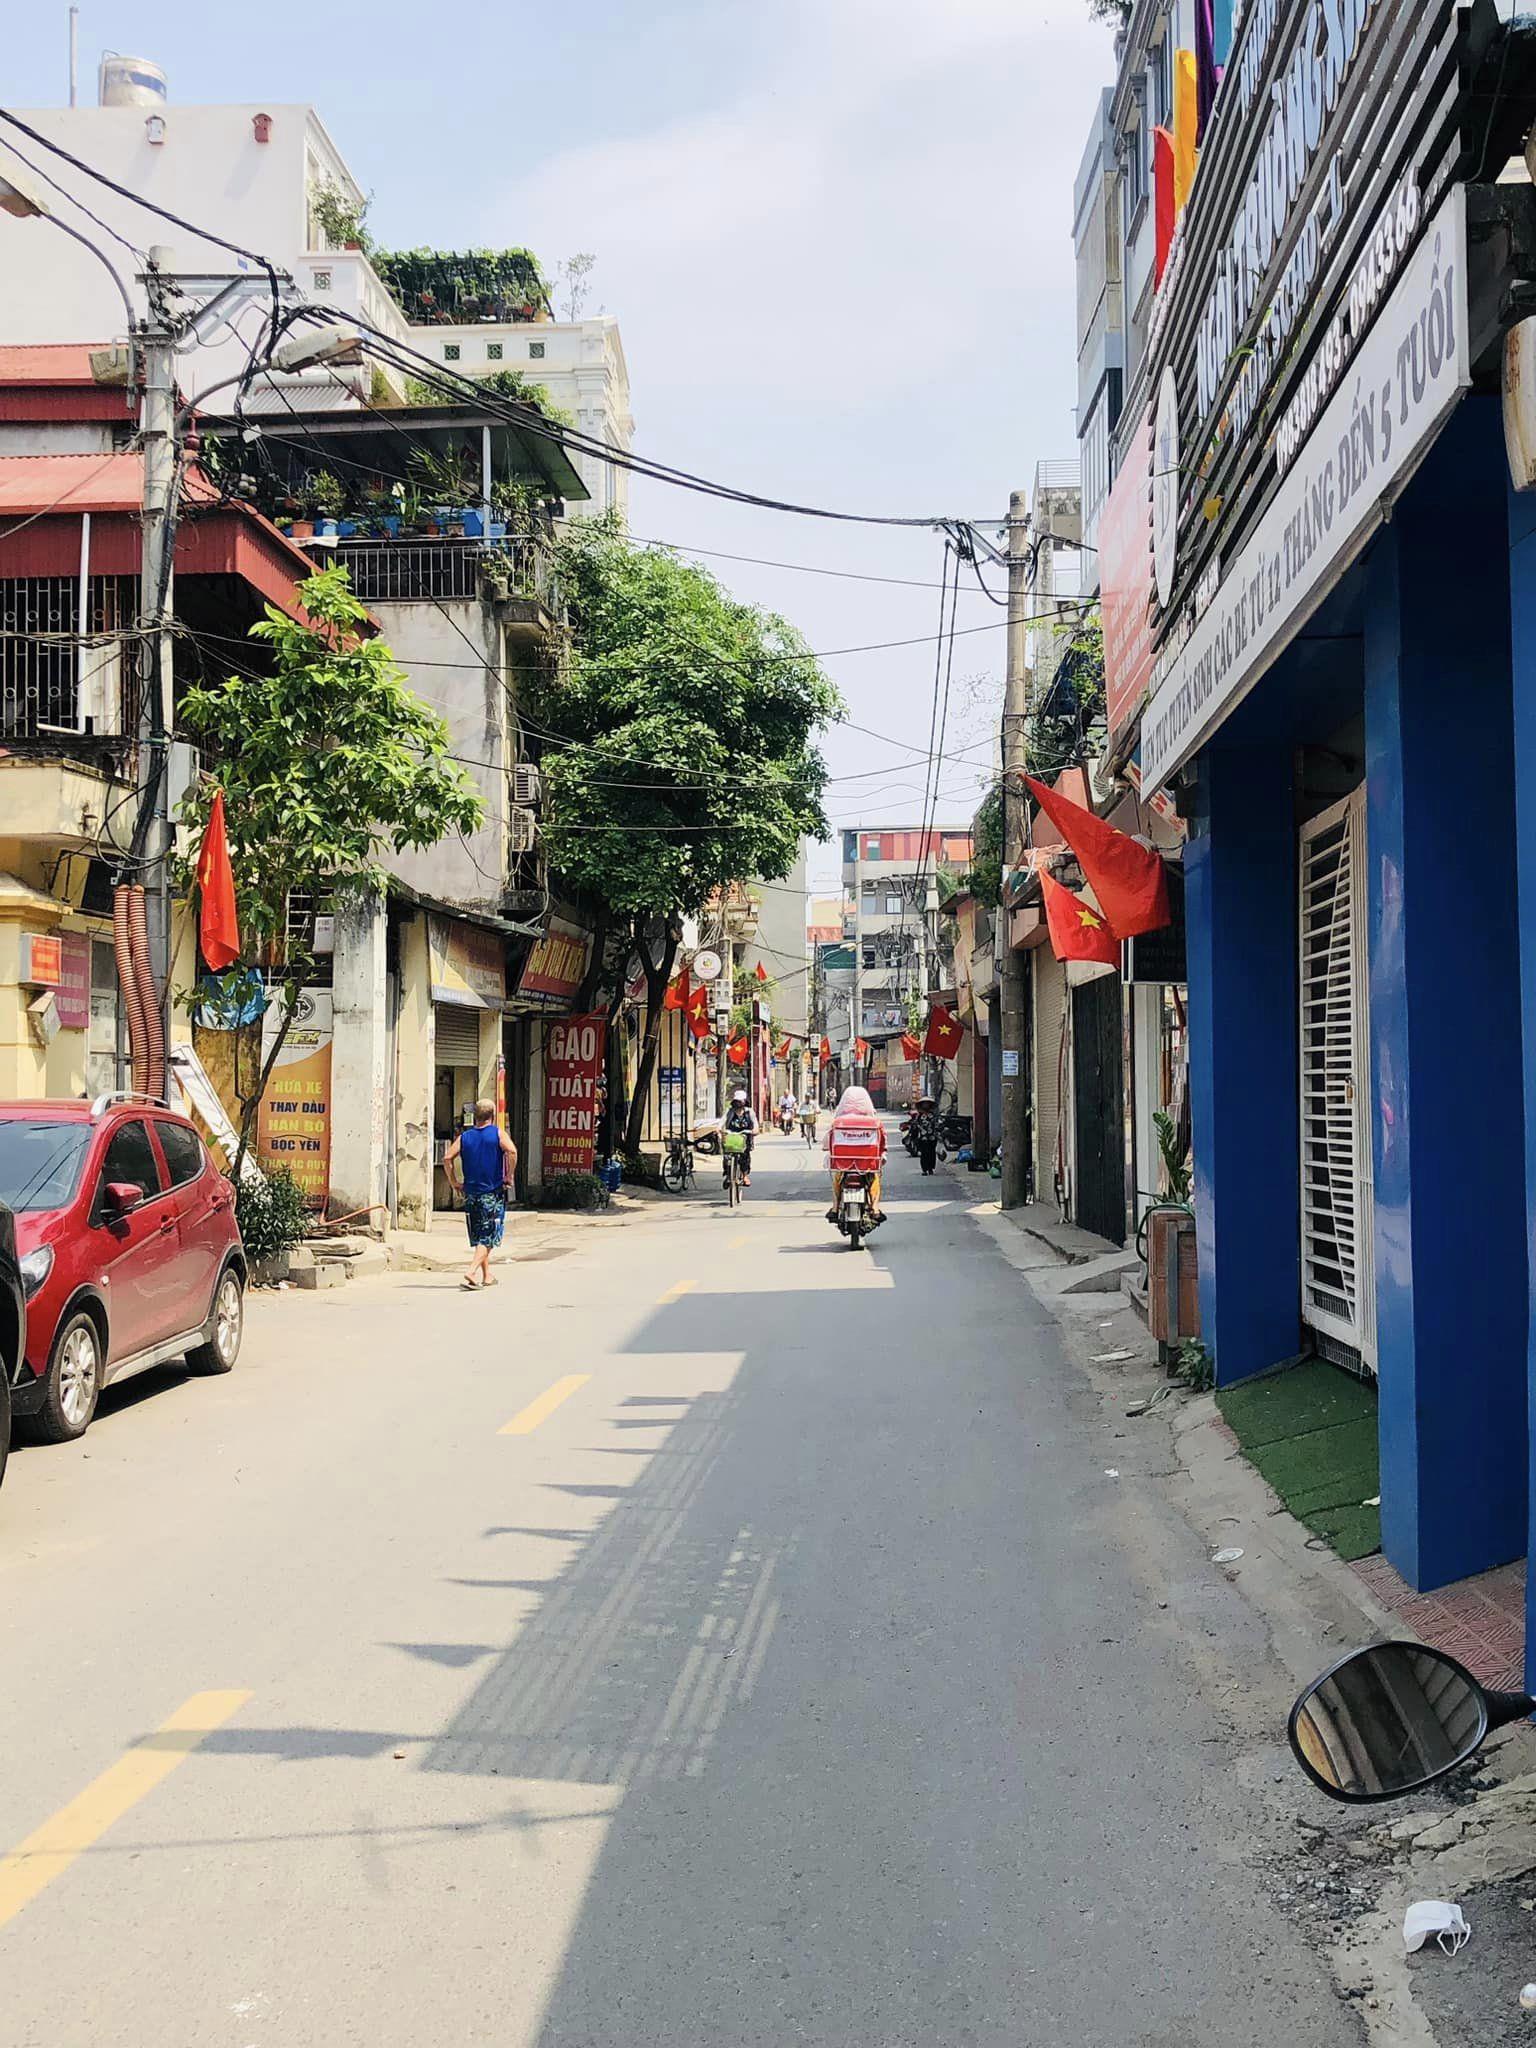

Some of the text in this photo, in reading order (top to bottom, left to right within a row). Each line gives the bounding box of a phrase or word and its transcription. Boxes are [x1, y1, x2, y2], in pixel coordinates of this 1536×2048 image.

[1271, 153, 1343, 364] SCHOL
[1194, 644, 1213, 714] SINH
[1215, 610, 1232, 685] CÁC
[1235, 576, 1247, 659] BÉ
[1250, 551, 1265, 638] TỪ
[1268, 551, 1281, 613] 12
[1284, 460, 1334, 589] THÁNG
[1338, 376, 1375, 514] ĐẾN
[1381, 378, 1392, 463] 5
[1397, 232, 1455, 426] TUỔI
[550, 1025, 596, 1069] GẠO
[549, 1071, 594, 1098] TUẤT
[270, 1101, 298, 1113] THAY
[548, 1106, 592, 1131] KIÊN
[271, 1140, 296, 1152] BỌC
[545, 1134, 592, 1149] BÁN BUÔN
[552, 1151, 571, 1164] BÁN
